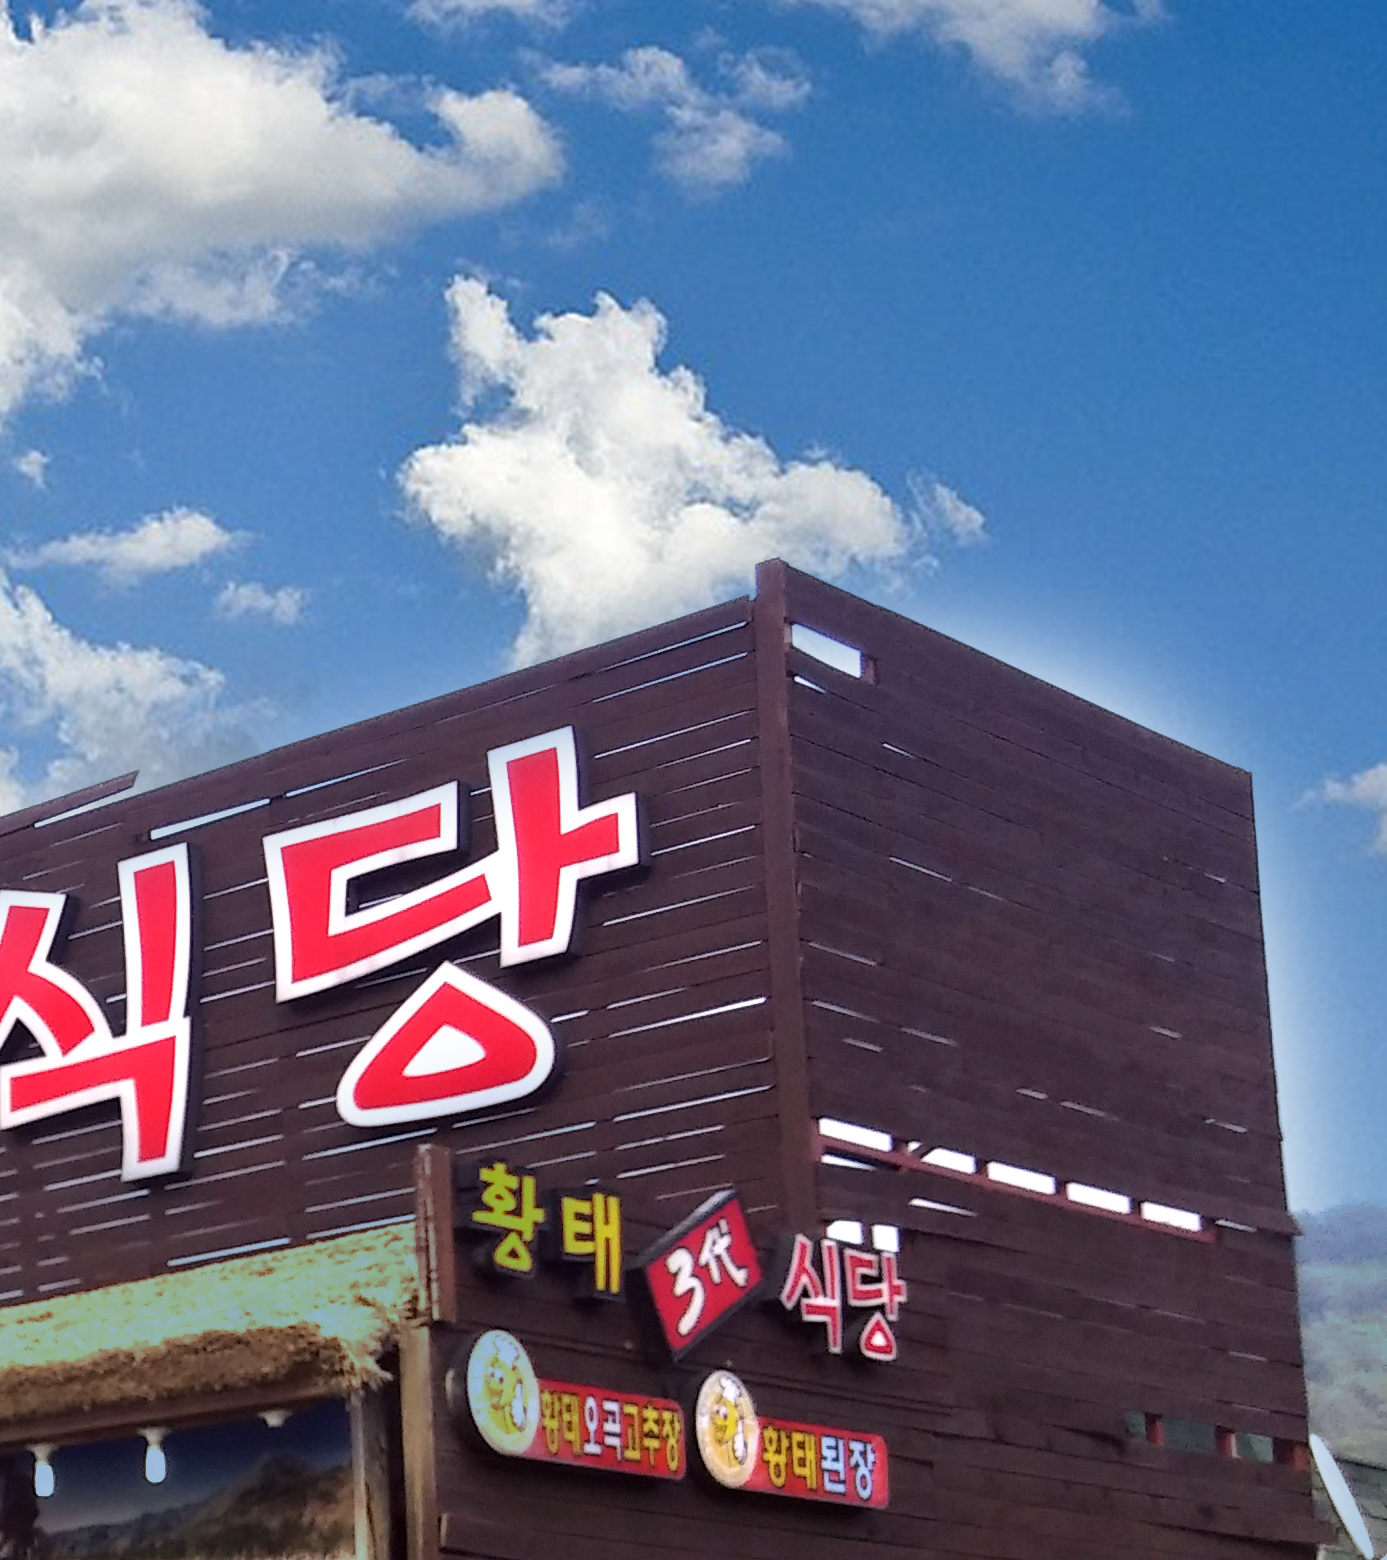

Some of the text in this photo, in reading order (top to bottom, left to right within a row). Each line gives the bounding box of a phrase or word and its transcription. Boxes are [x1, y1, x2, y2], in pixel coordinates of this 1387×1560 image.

[471, 1161, 908, 1362] 황태 3代 식당
[762, 1424, 875, 1501] 황태된장
